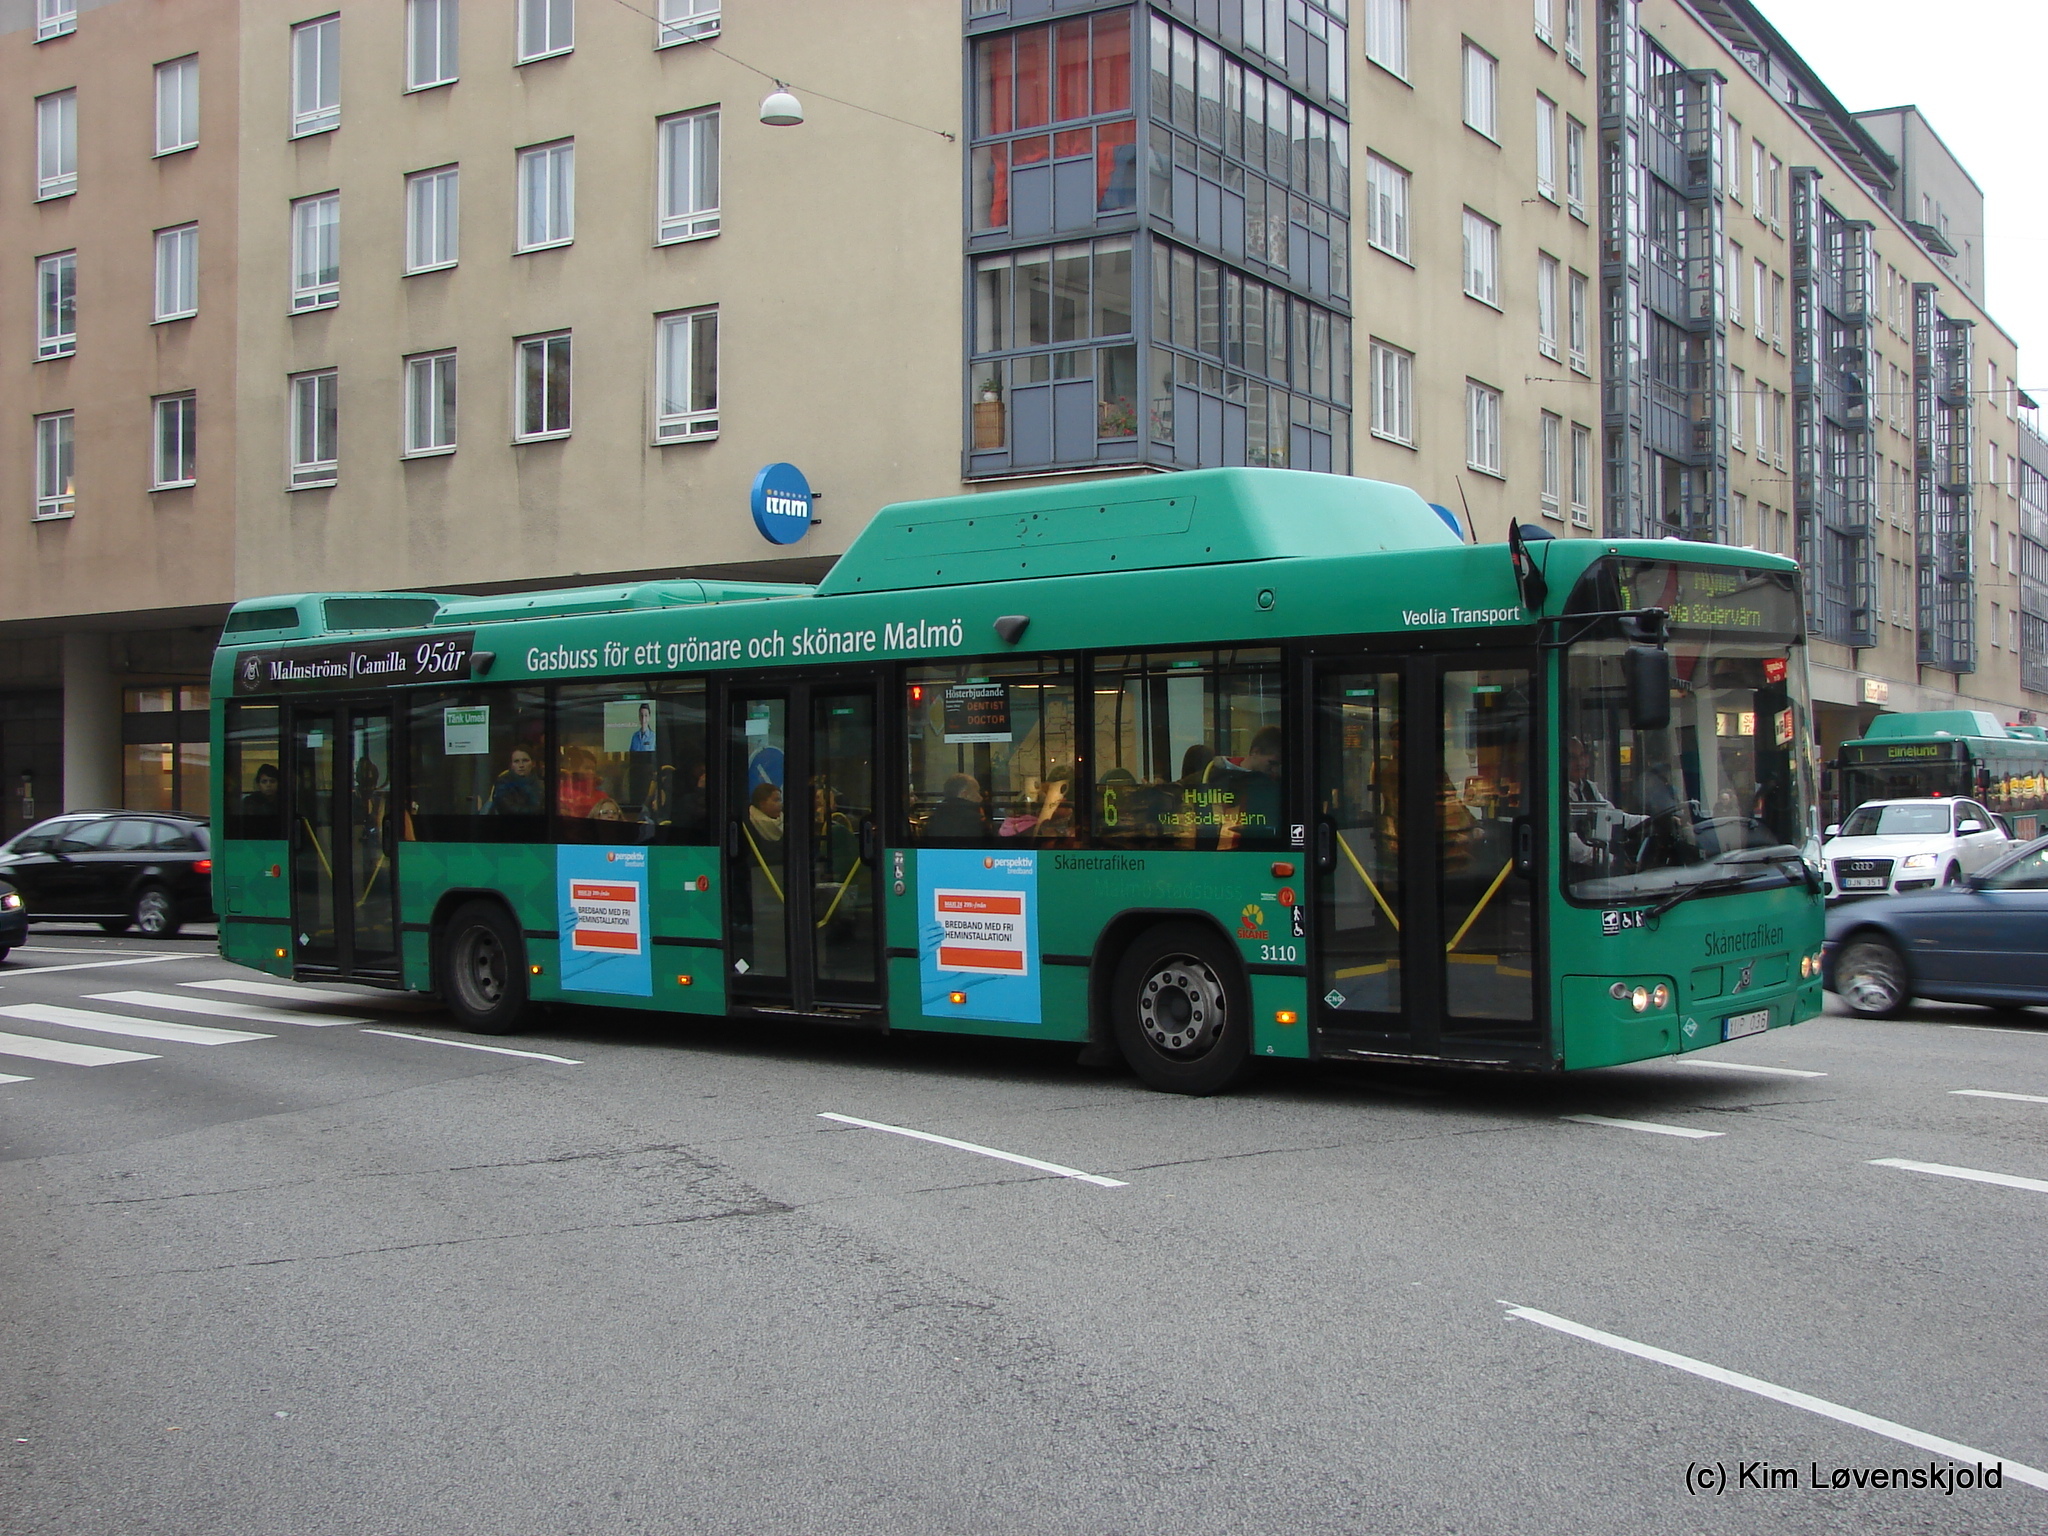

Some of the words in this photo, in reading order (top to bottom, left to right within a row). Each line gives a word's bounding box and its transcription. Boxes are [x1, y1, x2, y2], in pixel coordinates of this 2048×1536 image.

[1402, 608, 1447, 626] Veolia
[1451, 605, 1520, 626] Transport
[1693, 604, 1762, 627] Södervärn
[527, 645, 598, 672] Gasbuss
[604, 641, 630, 667] för
[634, 641, 661, 665] ett
[667, 637, 742, 669] grönare
[748, 629, 785, 659] och
[792, 627, 876, 657] skönare
[883, 618, 963, 651] Malmö
[270, 660, 348, 681] Malmströms
[356, 651, 407, 675] Camilla
[967, 701, 1004, 711] DENTIST
[967, 715, 1006, 725] DOCTOR
[1888, 745, 1938, 758] Elinelund
[1184, 788, 1235, 807] Hyllie
[1104, 788, 1119, 827] 6
[1158, 812, 1180, 825] via
[1184, 811, 1267, 826] Södervärn
[994, 857, 1033, 868] perspektiv
[1054, 854, 1145, 871] Skånetrafiken
[578, 906, 607, 916] BREDBAND
[608, 908, 621, 916] MED
[622, 909, 631, 917] FRI
[945, 920, 983, 930] BREDBAND
[984, 922, 1001, 931] MED
[1003, 923, 1014, 932] FRI
[945, 931, 1012, 942] HEMINSTALLATION!
[1705, 923, 1784, 957] Skånetrafiken
[1260, 944, 1296, 962] 3110
